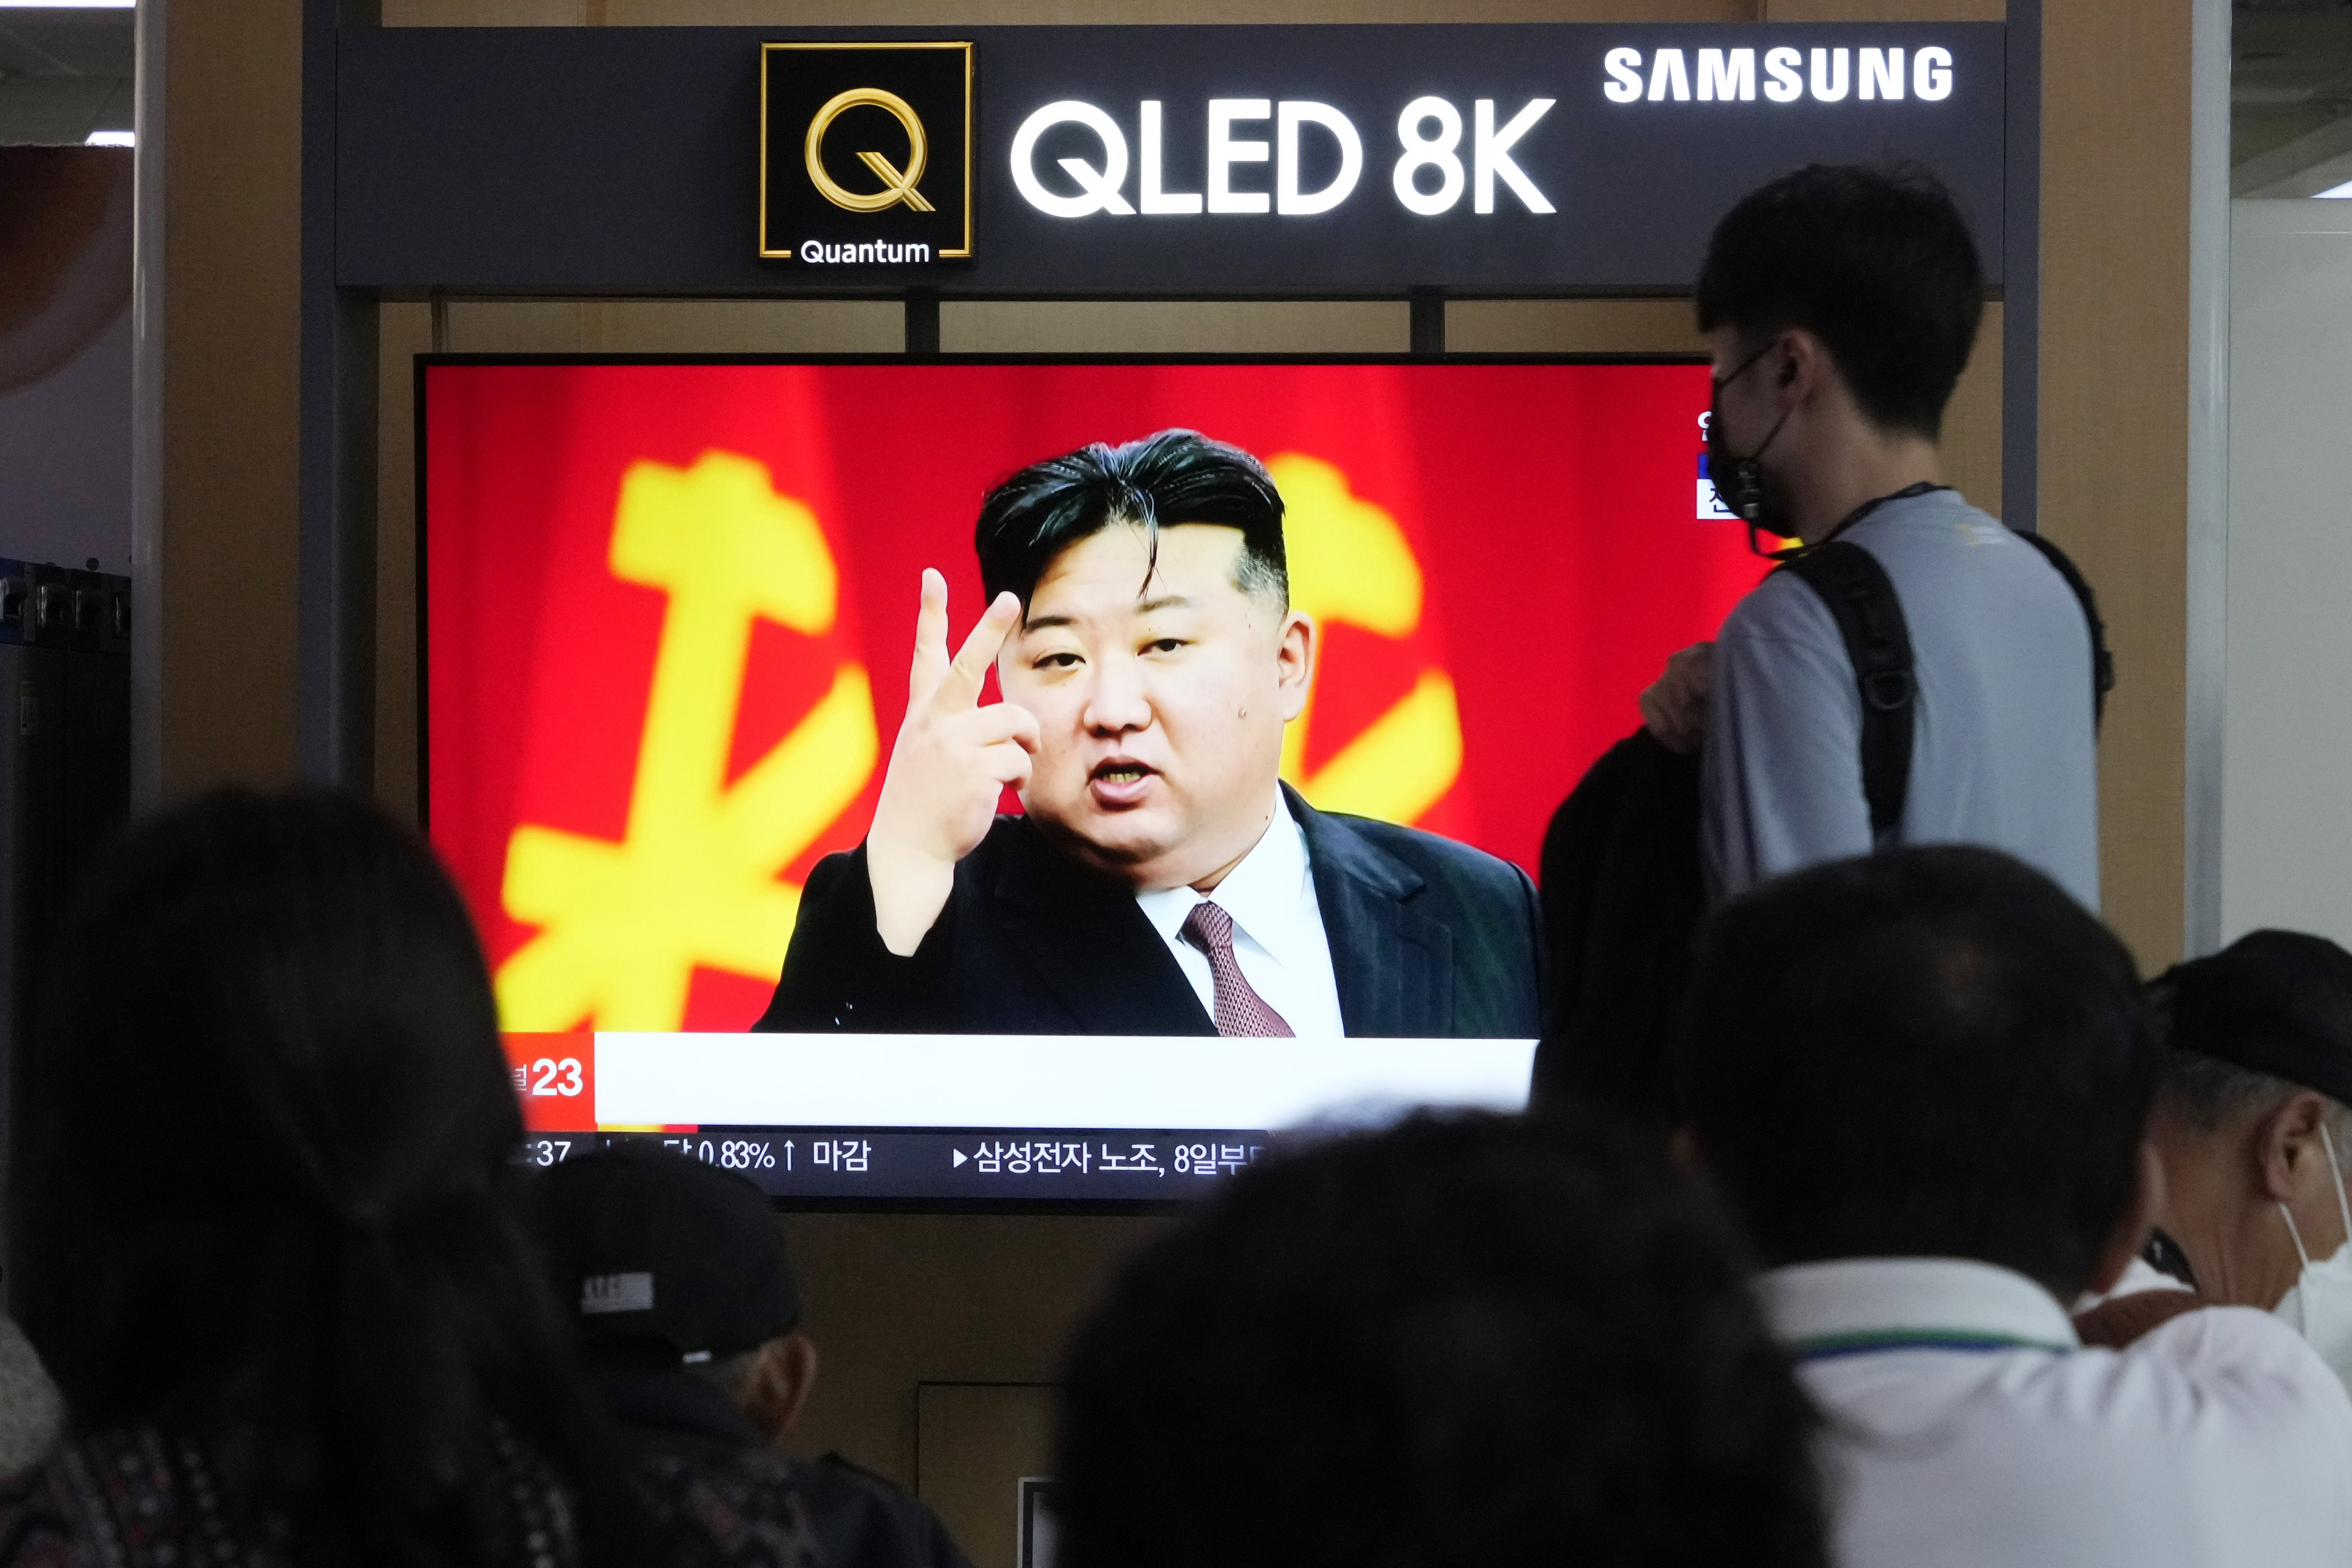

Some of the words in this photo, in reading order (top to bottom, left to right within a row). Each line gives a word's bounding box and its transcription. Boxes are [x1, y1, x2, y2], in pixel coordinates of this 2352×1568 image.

[1604, 47, 1952, 102] SAMSUNG
[805, 88, 936, 212] Q
[1011, 99, 1362, 217] QLED
[1393, 97, 1557, 215] 8K
[801, 240, 930, 263] Quantum
[813, 1140, 872, 1171] 마감
[973, 1141, 1092, 1174] 삼성전자
[1098, 1144, 1165, 1177] 노조,
